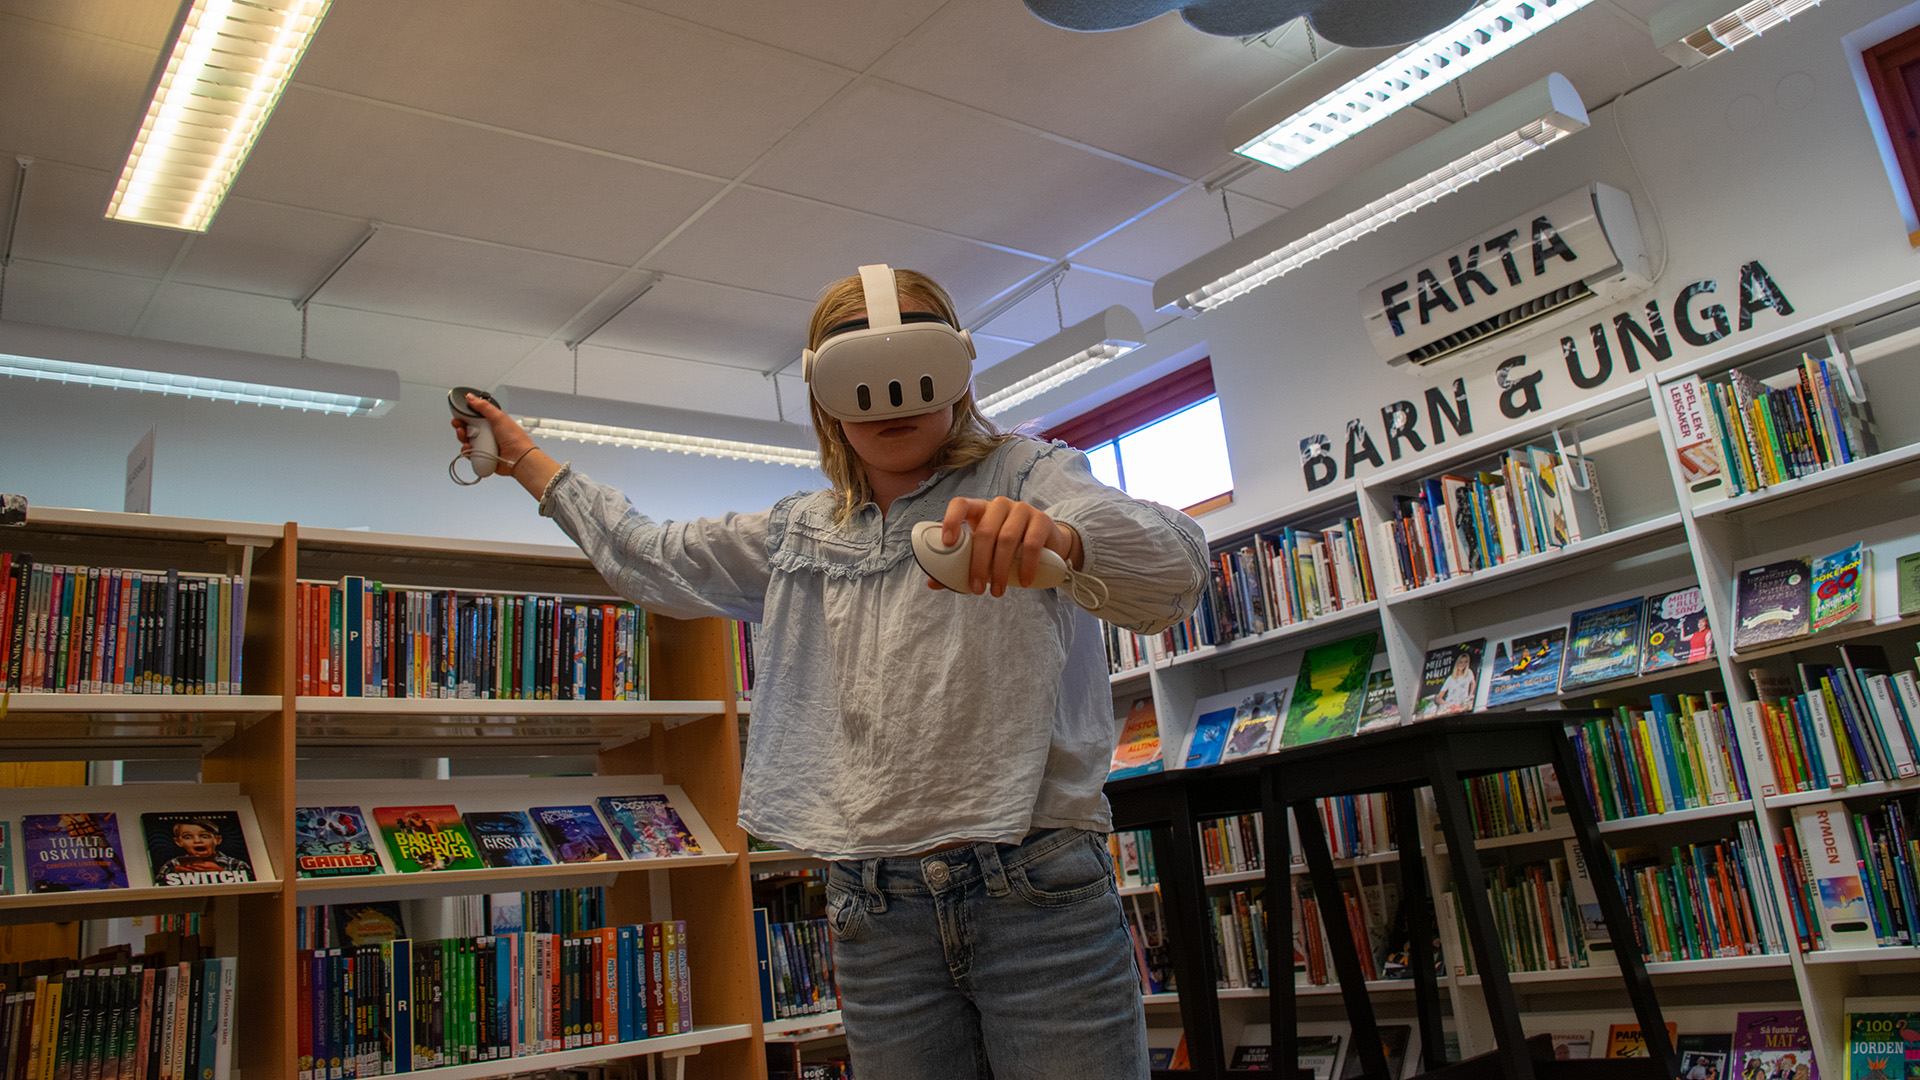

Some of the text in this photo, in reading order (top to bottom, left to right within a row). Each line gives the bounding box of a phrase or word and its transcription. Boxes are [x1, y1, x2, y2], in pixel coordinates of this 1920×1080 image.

[1379, 214, 1577, 338] FAKTA
[1296, 259, 1795, 493] BARN & UNGA
[1669, 386, 1691, 439] LEKSAKER
[1682, 381, 1706, 440] SPEL, LEK &
[1816, 568, 1858, 600] GO
[1668, 590, 1699, 603] MATTE
[1676, 597, 1698, 607] ALLT
[1815, 588, 1858, 613] HANDBOKEN
[1675, 604, 1699, 615] SANT
[13, 624, 24, 643] MIO,
[350, 631, 359, 641] P
[365, 619, 373, 647] GAMERS
[13, 643, 21, 660] MIN
[11, 661, 19, 678] MIO
[1493, 679, 1521, 694] BÖRJA
[1875, 679, 1885, 701] Militär
[1903, 676, 1917, 709] Matematik
[1746, 706, 1755, 725] Gåtor,
[1812, 694, 1821, 716] Trolleri
[1817, 722, 1826, 738] magi
[1750, 725, 1760, 741] knep
[1127, 739, 1160, 753] ALLTING
[1755, 746, 1764, 762] knåp
[610, 800, 666, 812] DOGSTARS
[49, 836, 100, 849] TOTALT
[394, 829, 467, 846] BARFOTA
[482, 836, 538, 849] GISSLAN
[1816, 809, 1841, 865] RYMDEN
[39, 847, 115, 862] OSKYLDIG
[399, 843, 475, 860] FOREVER
[301, 854, 378, 869] GAMER
[1573, 843, 1588, 880] IDROTT
[165, 870, 250, 887] SWITCH
[760, 960, 767, 970] T
[207, 991, 216, 1021] Jefferson
[223, 988, 232, 1017] Jefferson
[398, 1000, 407, 1011] R
[128, 1006, 138, 1028] Anne
[166, 1015, 175, 1031] VÄN
[318, 989, 327, 1046] SPIONGÄNGET
[333, 986, 342, 1043] SPIONGÄNGET
[78, 1009, 91, 1057] Drömmens
[108, 1008, 121, 1060] Drömslottet
[1759, 1025, 1799, 1035] Så funkar
[1865, 1020, 1893, 1032] 100
[62, 1030, 71, 1046] vän
[91, 1011, 105, 1069] Anne på egen
[126, 1030, 136, 1041] på
[174, 1008, 186, 1080] FLAMINGOPOJKEN
[1765, 1035, 1795, 1049] MAT
[1852, 1041, 1904, 1055] JORDEN
[60, 1050, 70, 1073] Anne
